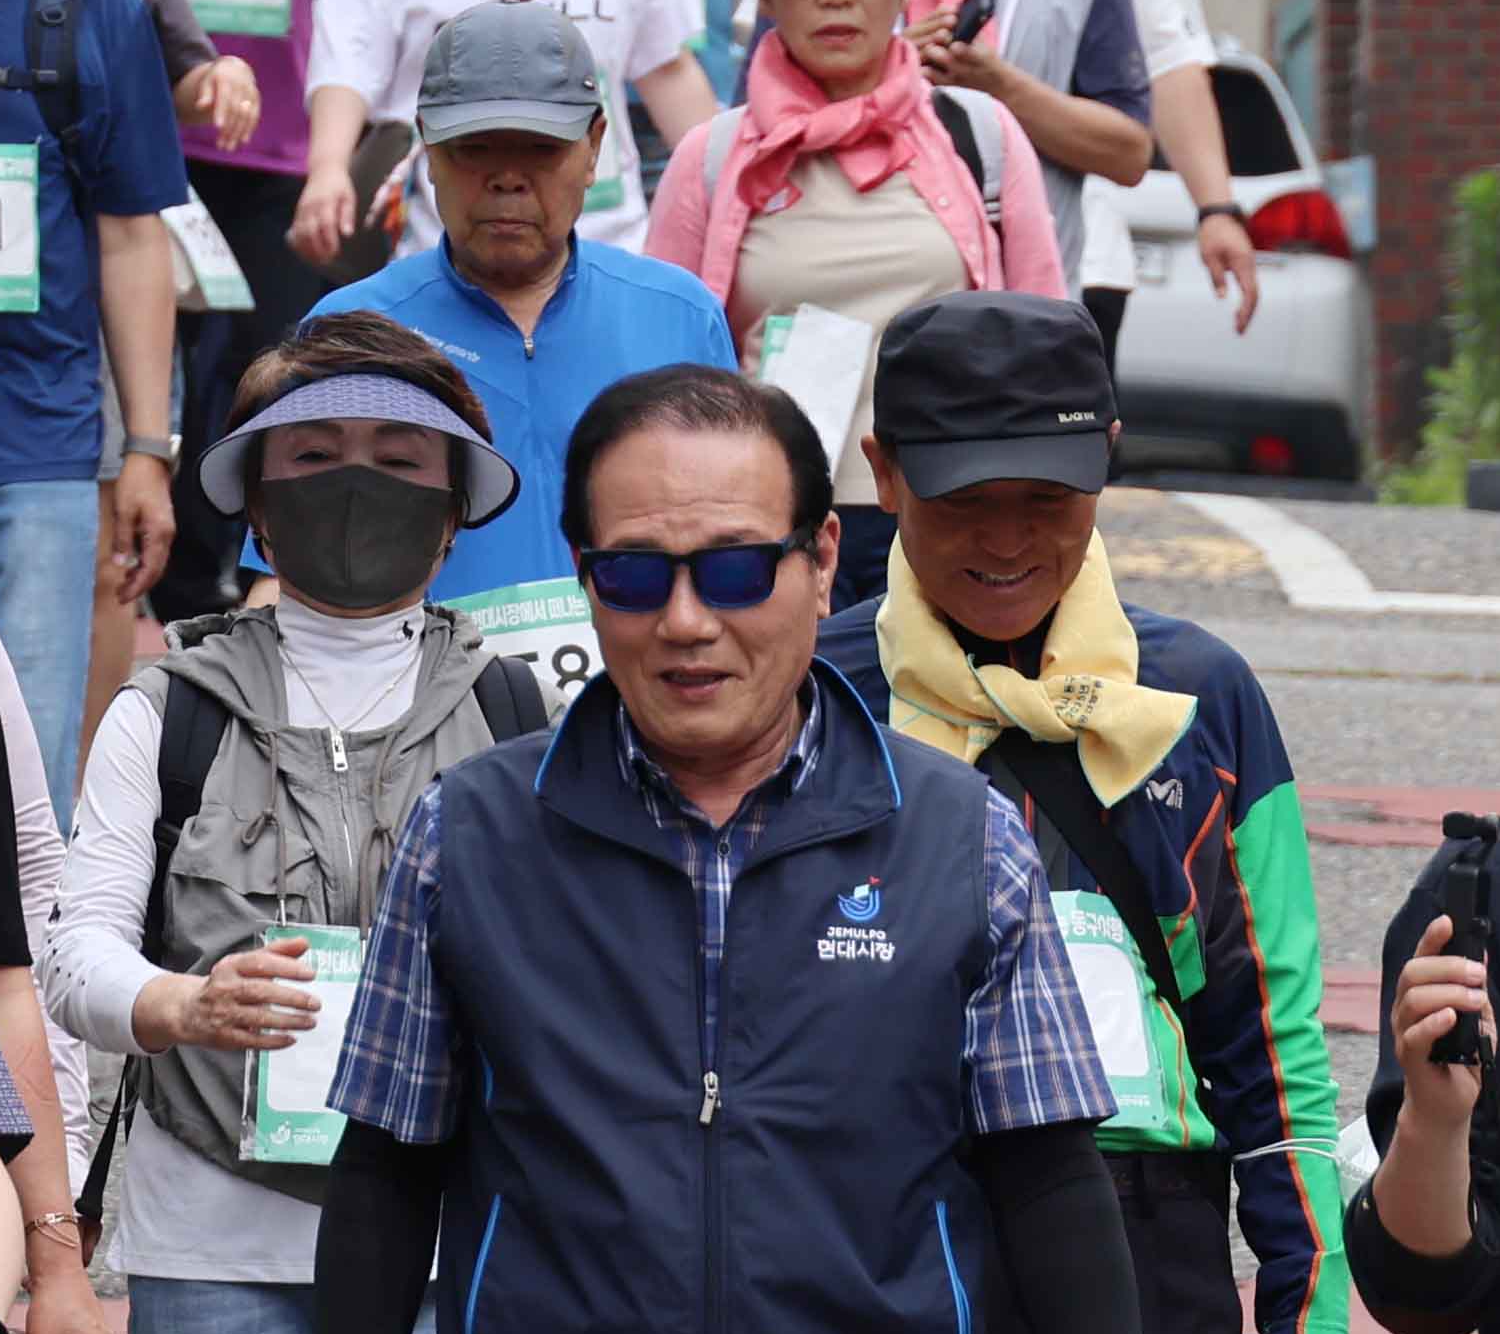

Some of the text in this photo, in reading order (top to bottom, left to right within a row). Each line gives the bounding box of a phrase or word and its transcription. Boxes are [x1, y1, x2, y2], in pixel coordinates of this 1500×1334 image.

[501, 644, 589, 691] 8
[826, 926, 887, 939] JEMULPO
[817, 939, 896, 962] 현대시장
